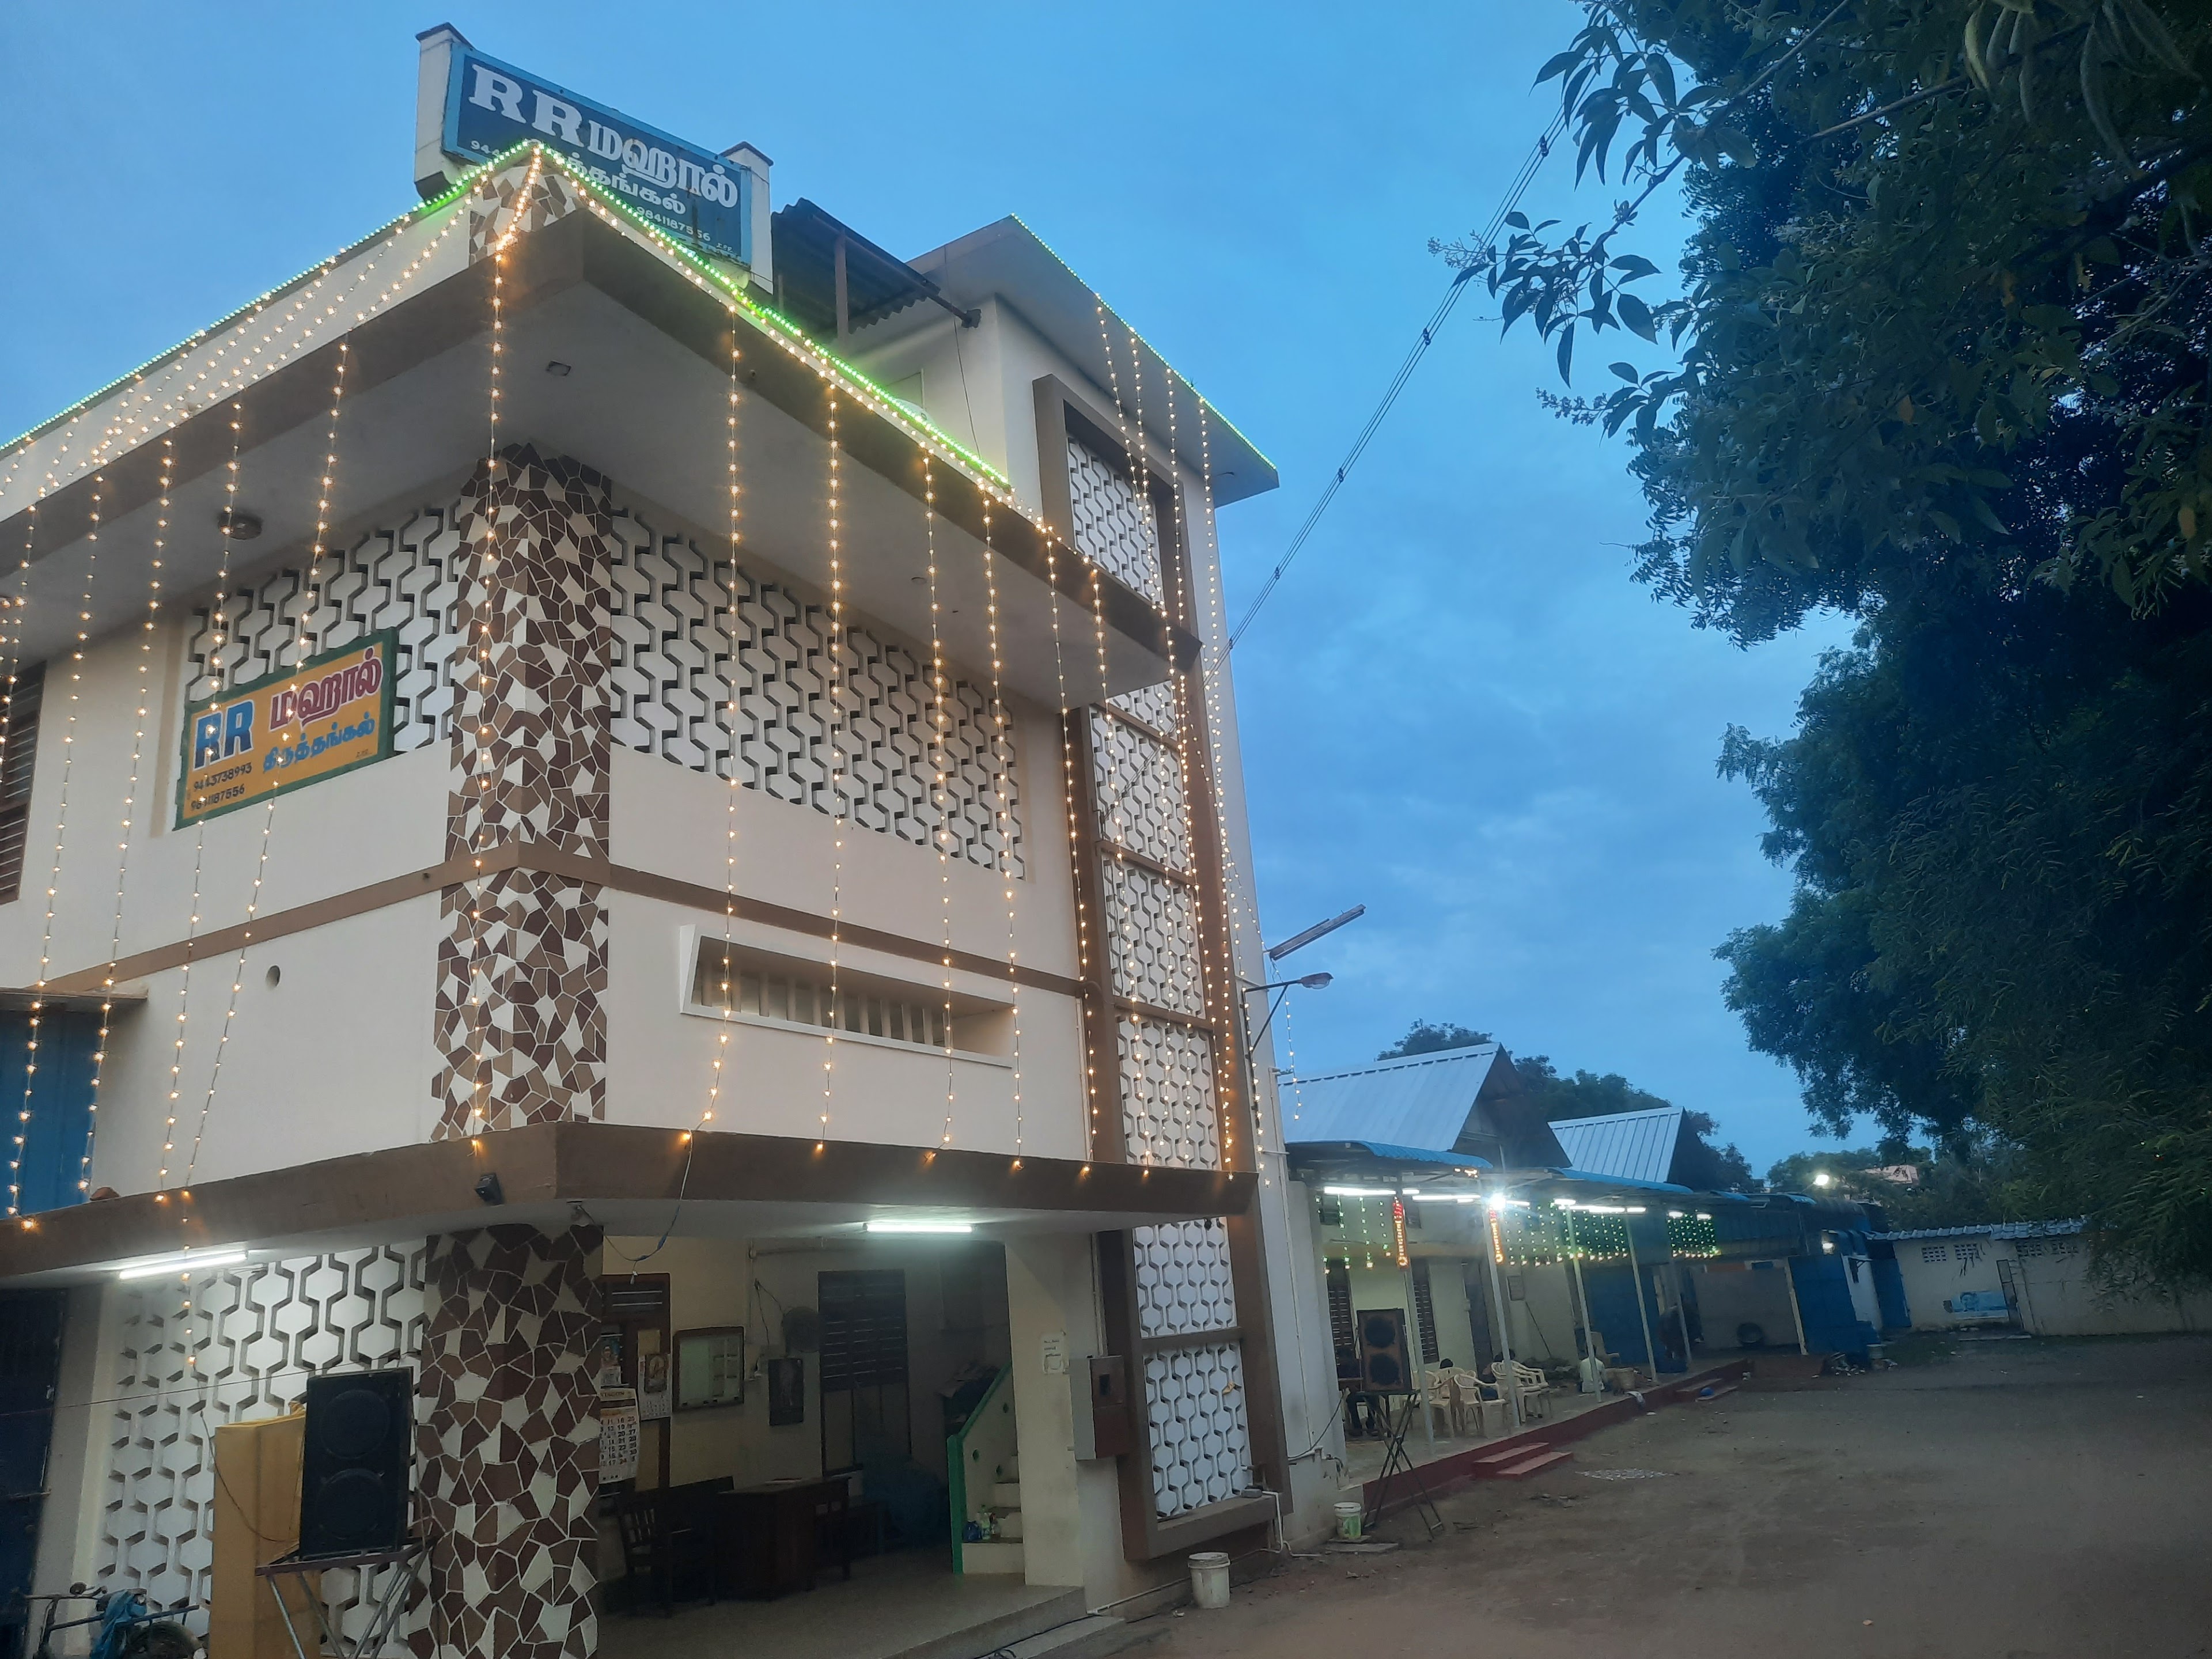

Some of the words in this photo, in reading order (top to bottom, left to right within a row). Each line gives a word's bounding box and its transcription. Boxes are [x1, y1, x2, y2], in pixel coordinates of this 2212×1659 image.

[636, 206, 711, 241] 9841187556
[194, 699, 255, 771] RR
[269, 646, 382, 731] மஹால்
